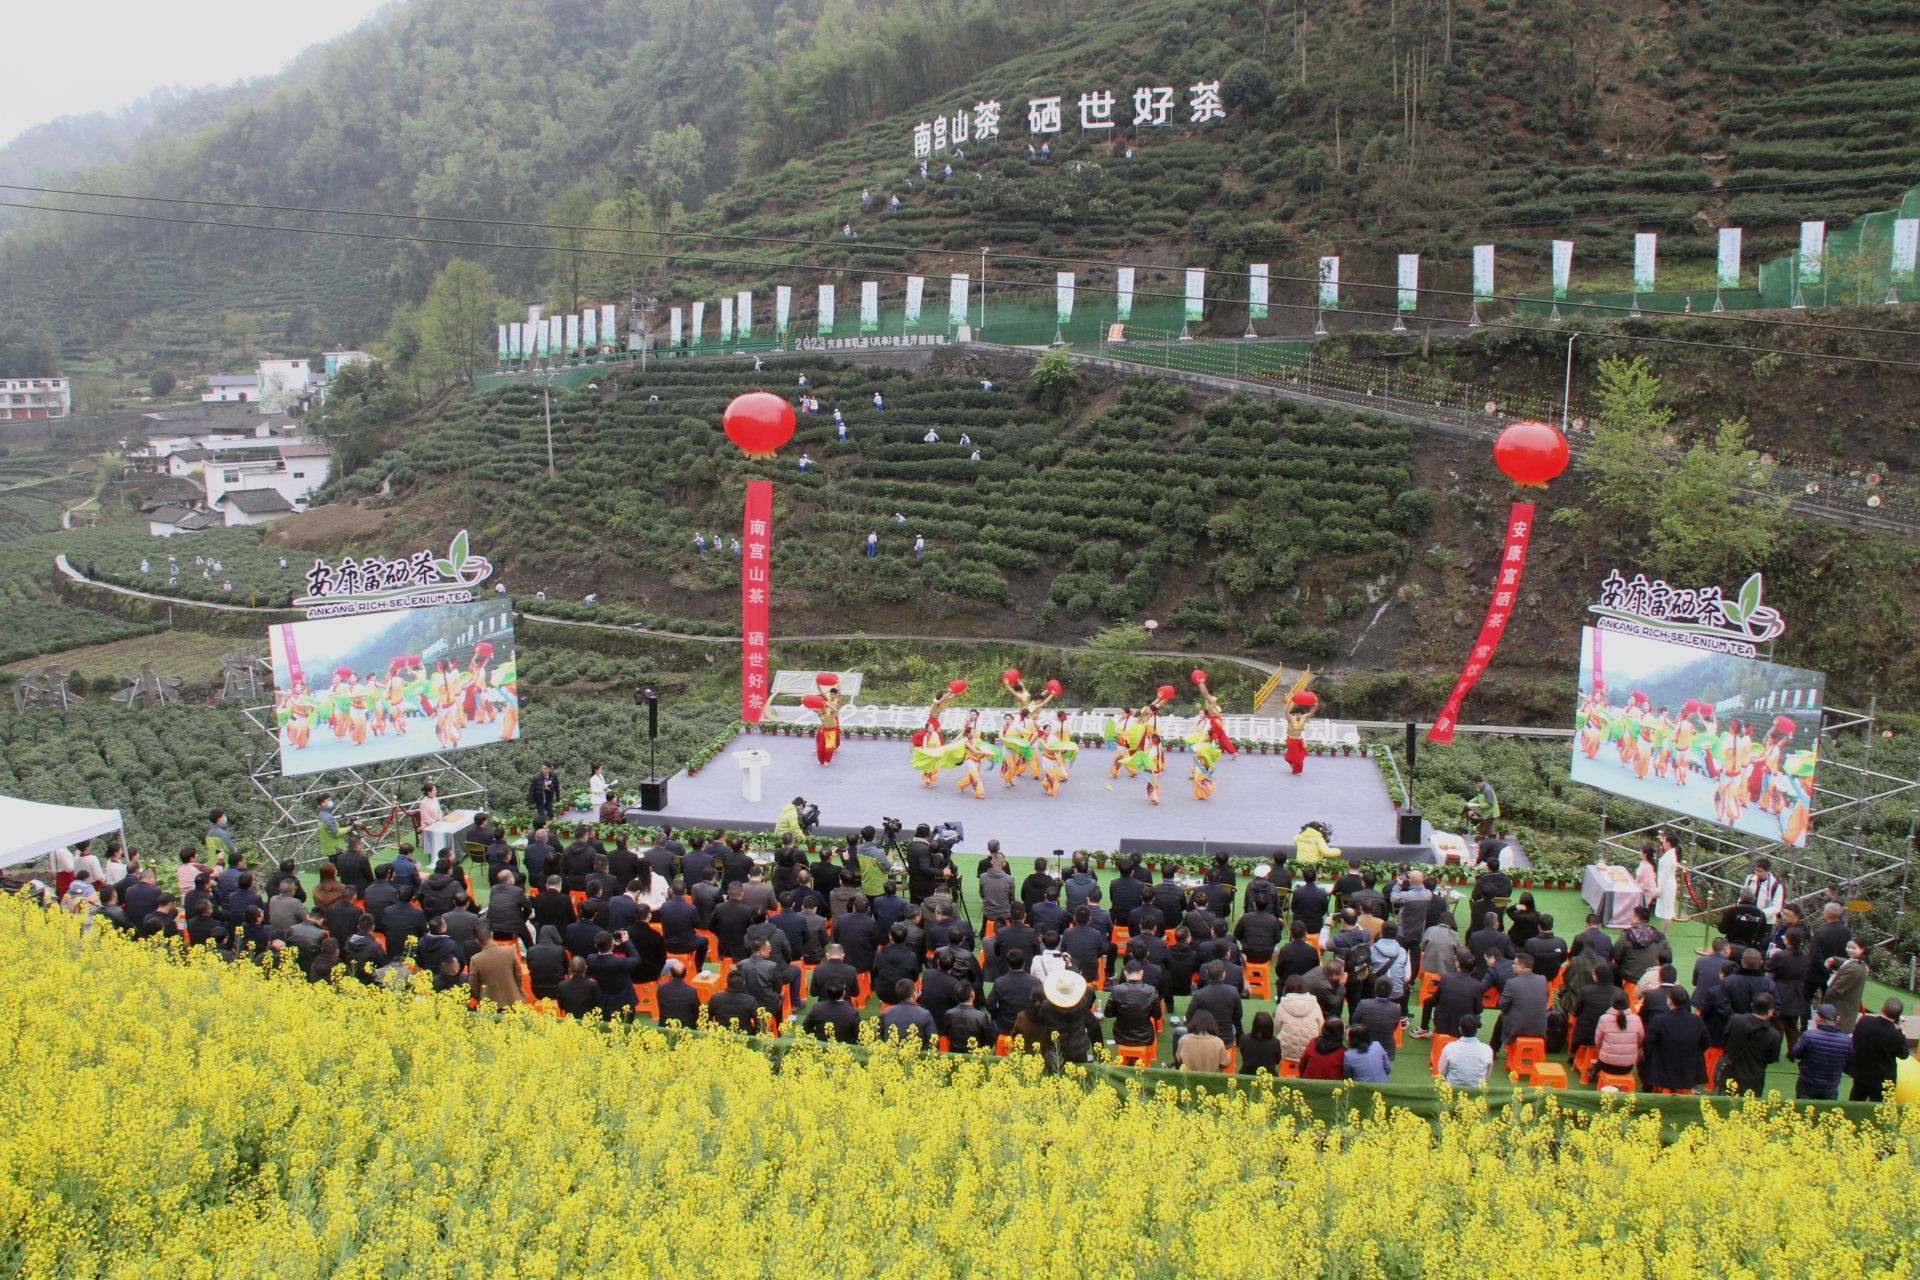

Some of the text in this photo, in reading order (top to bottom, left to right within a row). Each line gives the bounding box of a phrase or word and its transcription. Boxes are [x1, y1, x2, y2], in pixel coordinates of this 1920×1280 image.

[913, 80, 1226, 159] 南宫山茶 硒世好茶
[308, 551, 440, 597] 安康富硒茶
[1487, 521, 1528, 628] 安康富硒茶
[1601, 570, 1726, 626] 安康富硒茶
[308, 591, 472, 618] ANKANG RICH-SELENIUM TEA
[747, 518, 767, 710] 南宫山茶 硒世好茶
[1599, 617, 1756, 657] ANKANG RICH-SELENIUM TEA
